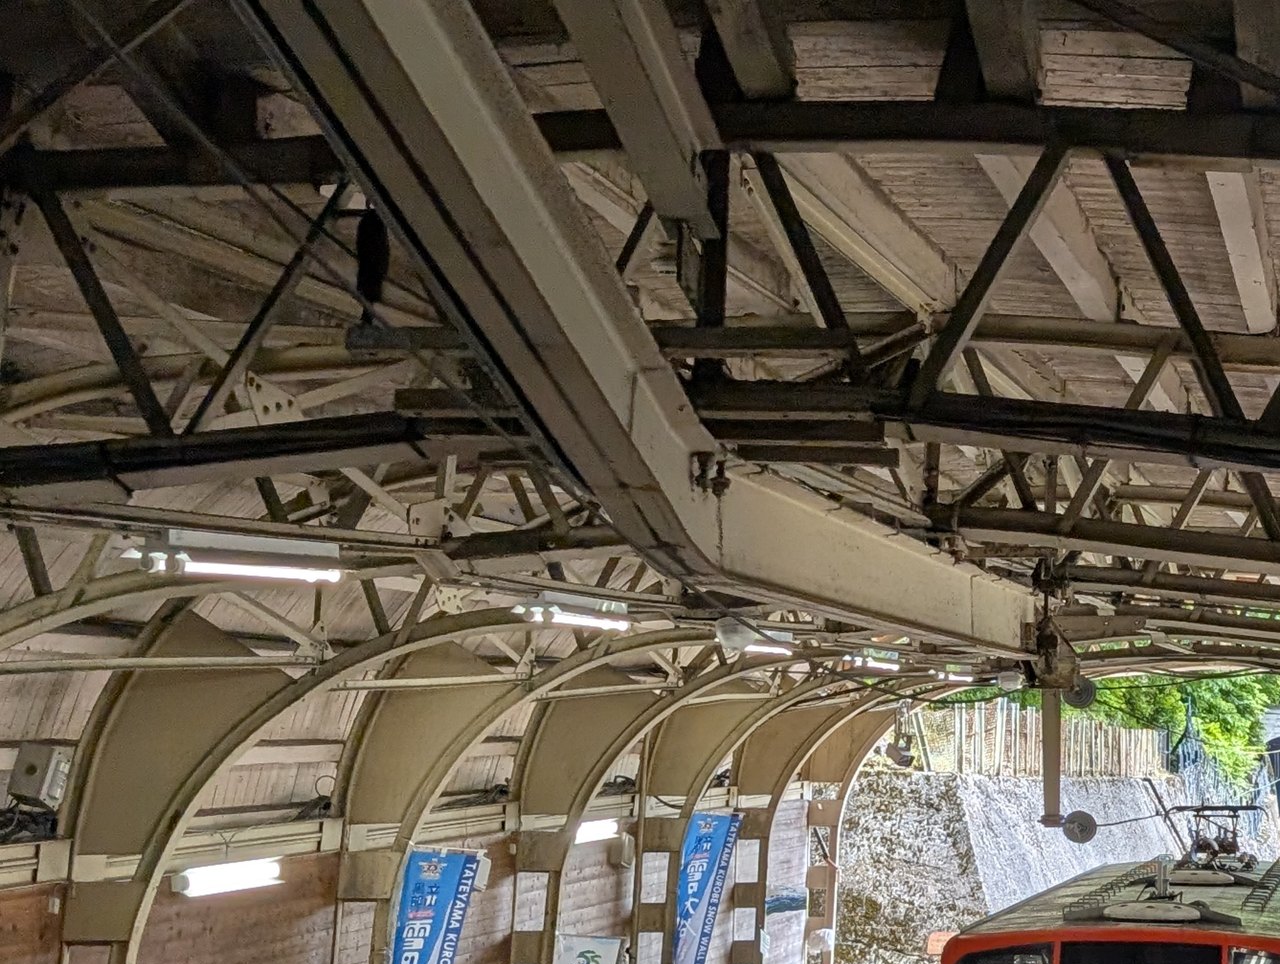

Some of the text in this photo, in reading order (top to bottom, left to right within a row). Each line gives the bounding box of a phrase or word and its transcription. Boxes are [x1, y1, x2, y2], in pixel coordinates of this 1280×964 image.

[448, 863, 477, 929] TATEYAMA
[710, 869, 725, 903] KUROBE
[703, 905, 717, 934] SNOW
[696, 937, 710, 960] WALL
